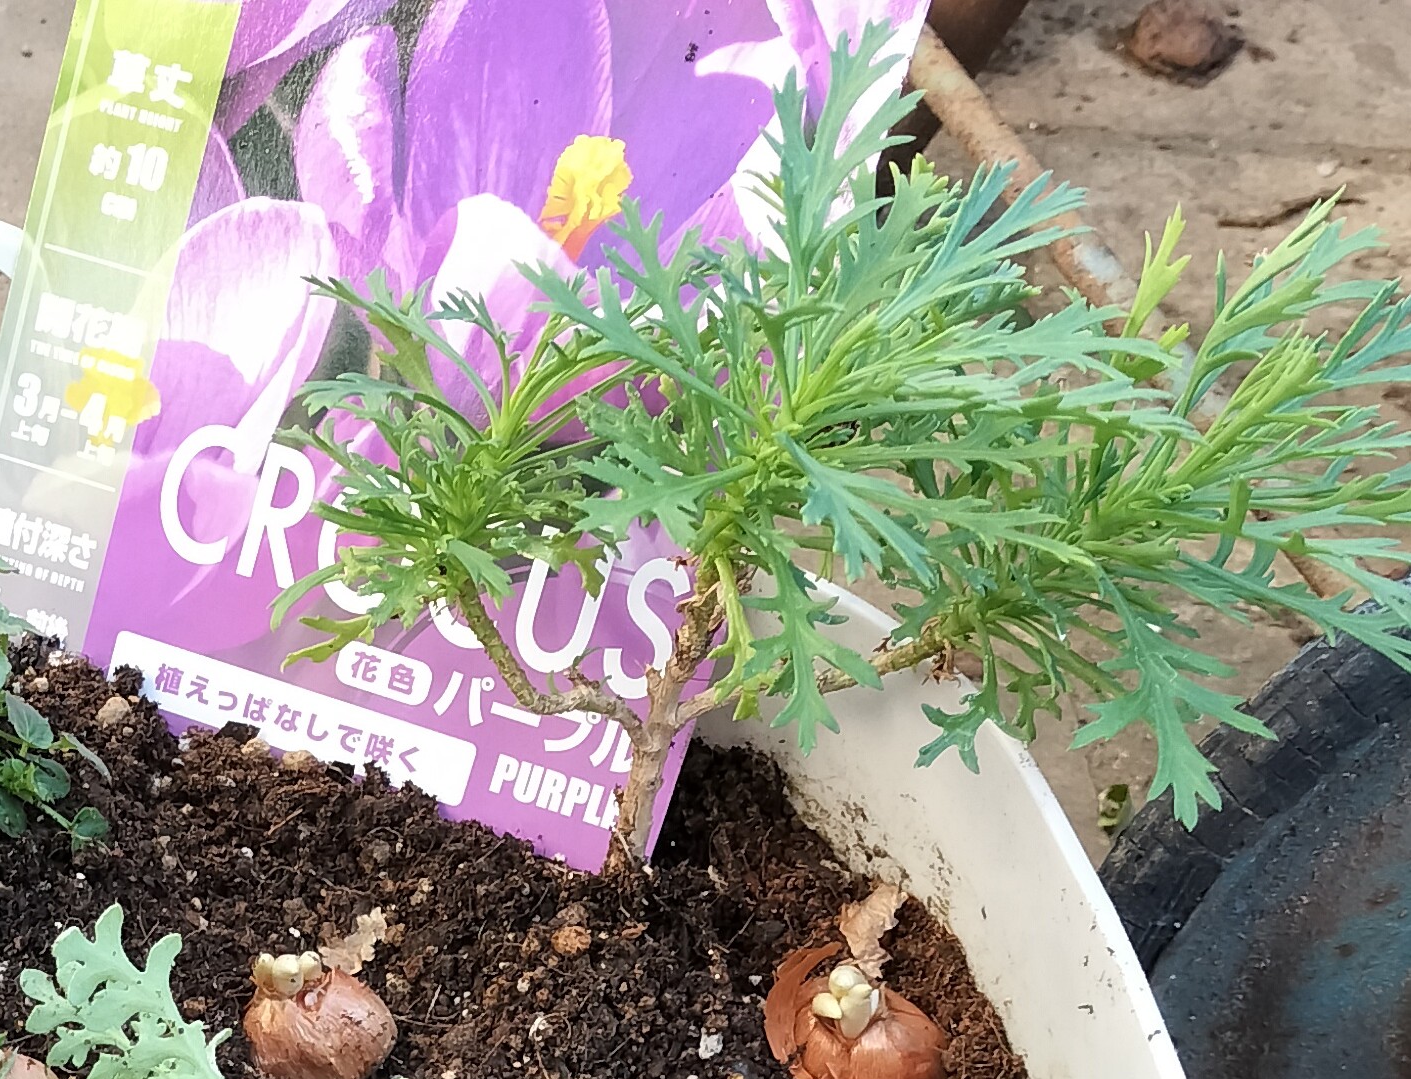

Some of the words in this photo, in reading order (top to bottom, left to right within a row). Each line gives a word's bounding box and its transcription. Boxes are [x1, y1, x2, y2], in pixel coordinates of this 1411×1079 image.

[154, 664, 420, 773] 植えっぱなしで咲く
[351, 651, 416, 695] 花色
[433, 670, 634, 773] パープル
